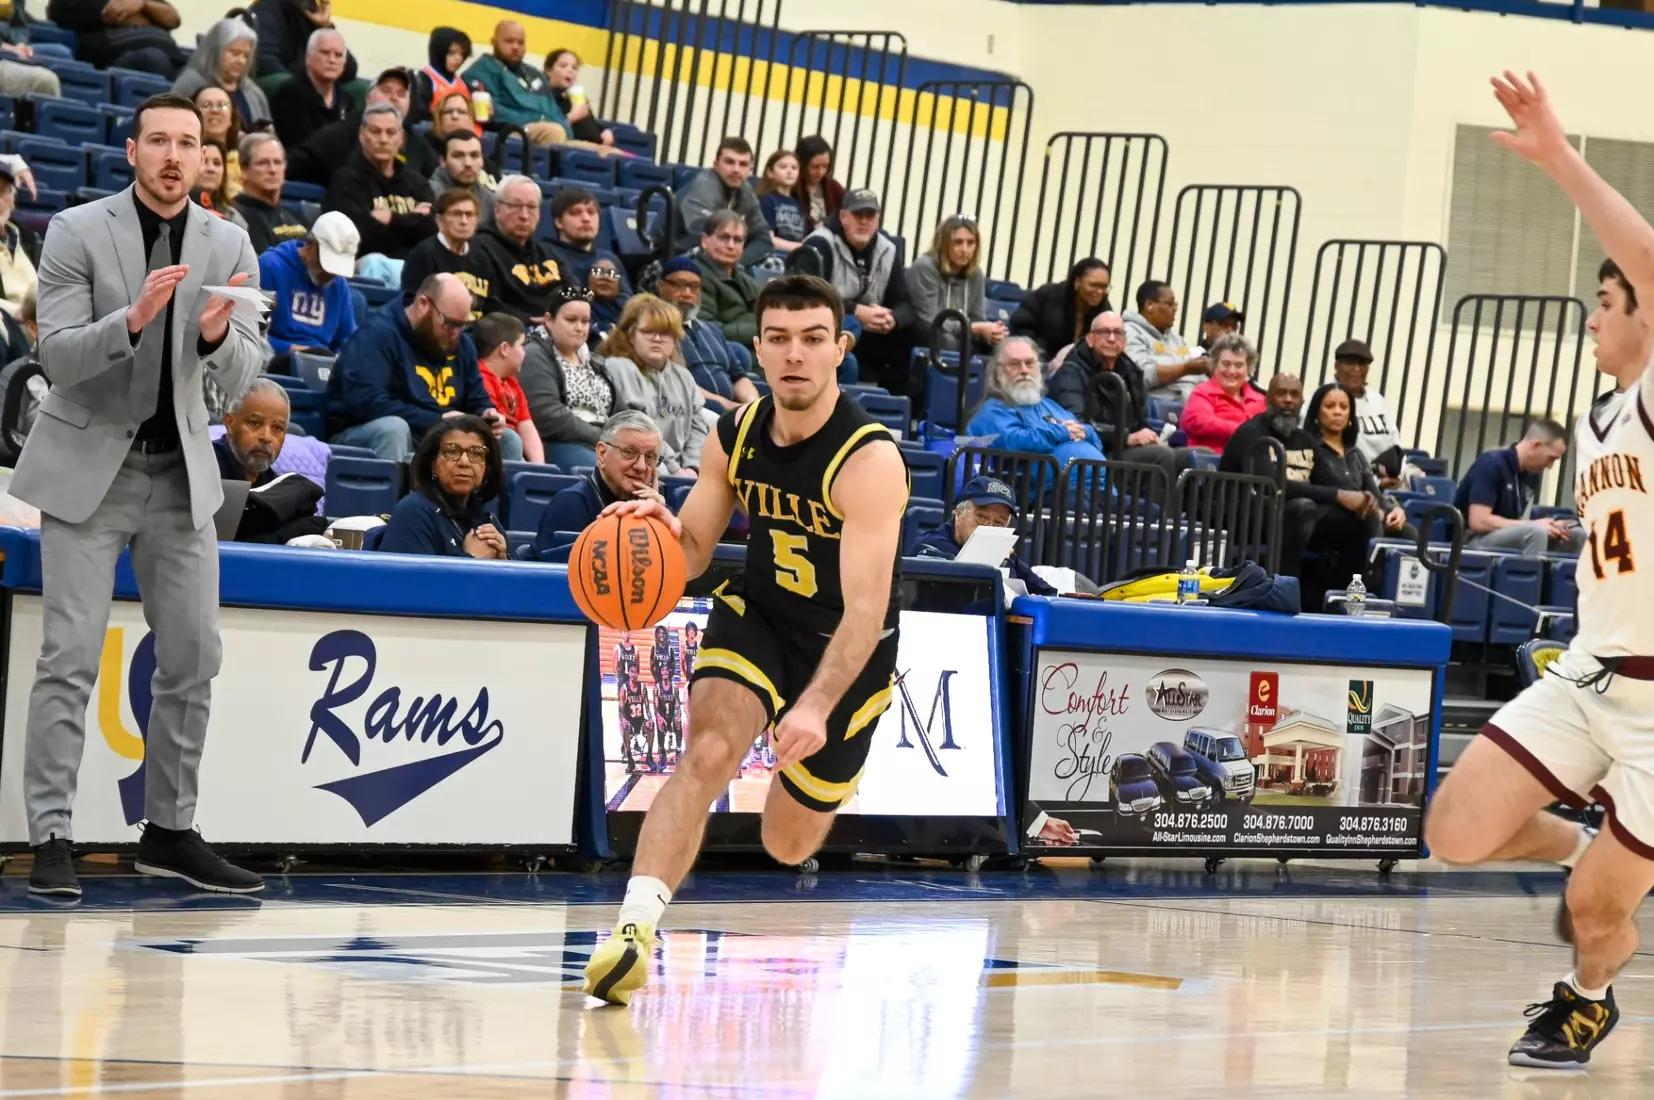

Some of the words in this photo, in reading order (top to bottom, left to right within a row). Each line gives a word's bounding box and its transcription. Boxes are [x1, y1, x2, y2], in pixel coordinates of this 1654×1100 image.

[734, 478, 841, 540] VILLE
[1588, 507, 1636, 580] 14
[628, 527, 652, 604] Wilson
[768, 529, 818, 598] 5
[301, 629, 504, 767] Rams
[1042, 662, 1129, 738] Comfort
[1250, 704, 1275, 716] Clarion
[1054, 721, 1114, 801] Style
[1152, 831, 1226, 843] All-StarLimousine.com
[1154, 813, 1228, 829] 304.876.2500
[1233, 832, 1320, 845] ClarionShepherdstown.com
[1243, 814, 1314, 830] 304.876.7000
[1325, 833, 1417, 847] QualityInnShepherdstown.com
[1339, 816, 1408, 832] 304.876.3160
